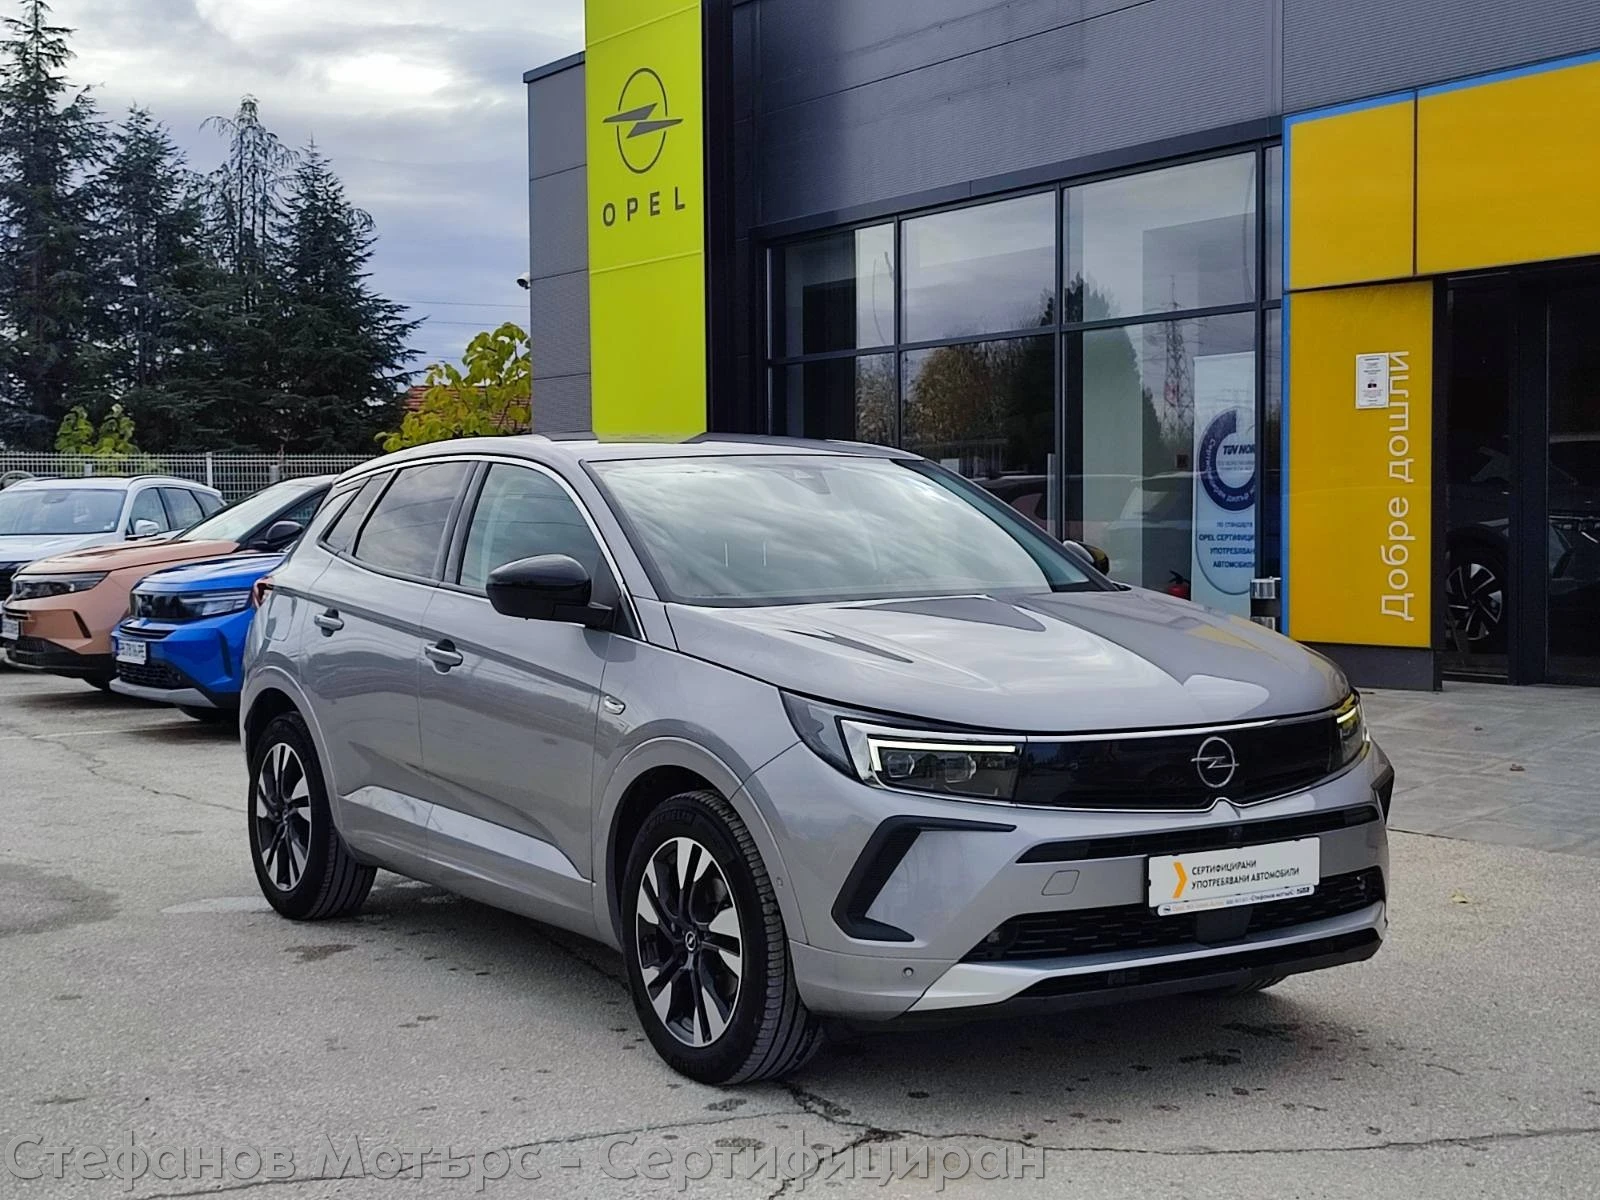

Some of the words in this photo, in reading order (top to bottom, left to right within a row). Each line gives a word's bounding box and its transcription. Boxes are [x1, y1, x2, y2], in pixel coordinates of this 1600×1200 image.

[603, 186, 686, 227] OPEL
[1388, 351, 1415, 483] дошли
[1380, 496, 1416, 622] Добре
[1191, 875, 1250, 890] УПОТРЕБЯВАНИ
[1251, 867, 1300, 882] АВТОМОБИЛИ
[1192, 860, 1257, 876] СЕРТИФИЦИРАНИ
